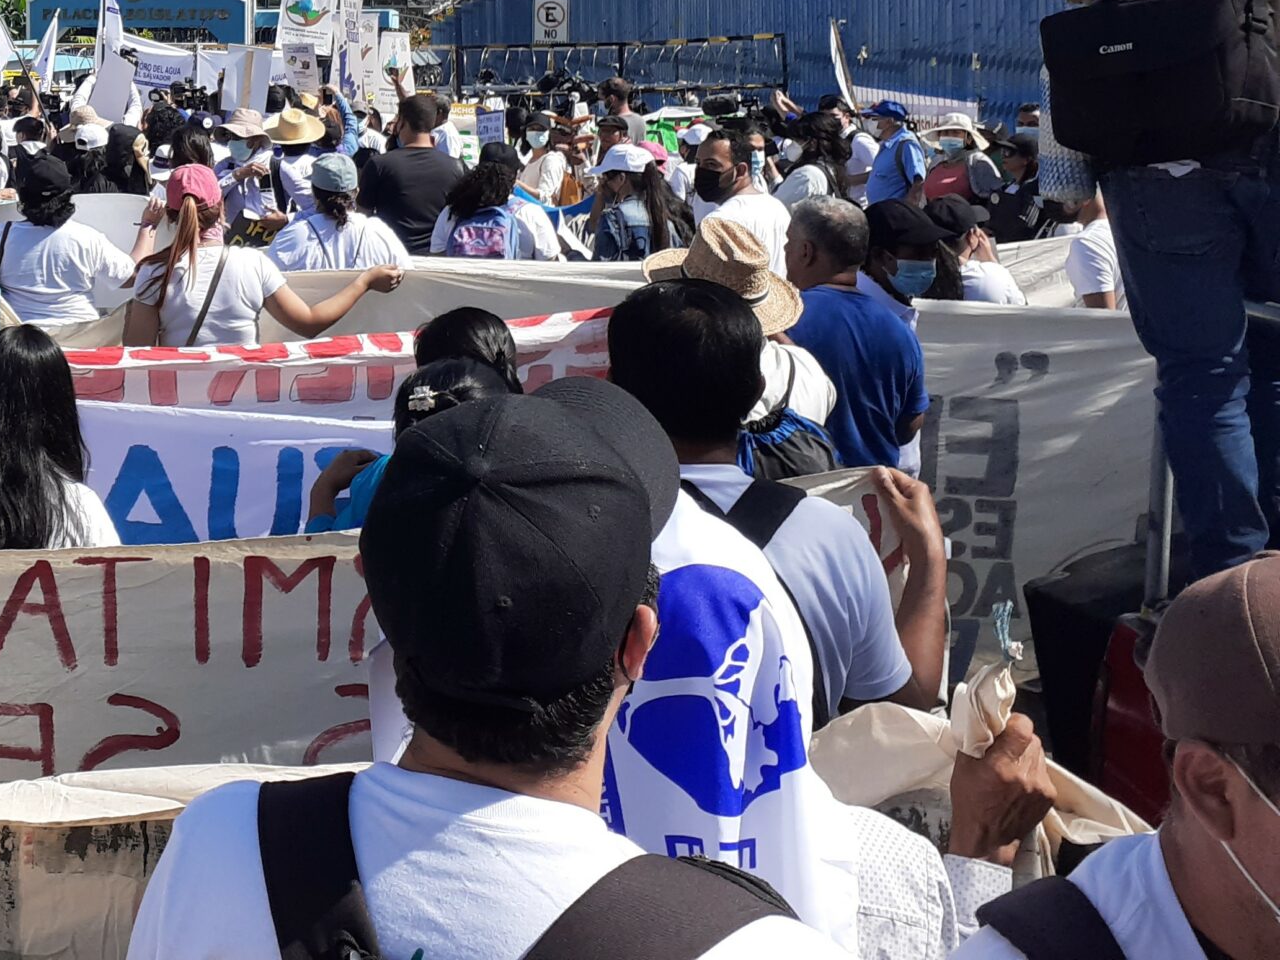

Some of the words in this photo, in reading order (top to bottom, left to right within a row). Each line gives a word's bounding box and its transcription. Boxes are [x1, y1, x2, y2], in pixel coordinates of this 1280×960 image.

[544, 29, 557, 39] NO
[1099, 41, 1133, 55] Canon
[139, 61, 152, 72] ORO
[153, 64, 164, 74] DEL
[165, 66, 181, 76] AGUA
[143, 72, 171, 81] SALVADOR
[271, 73, 287, 82] AGUA
